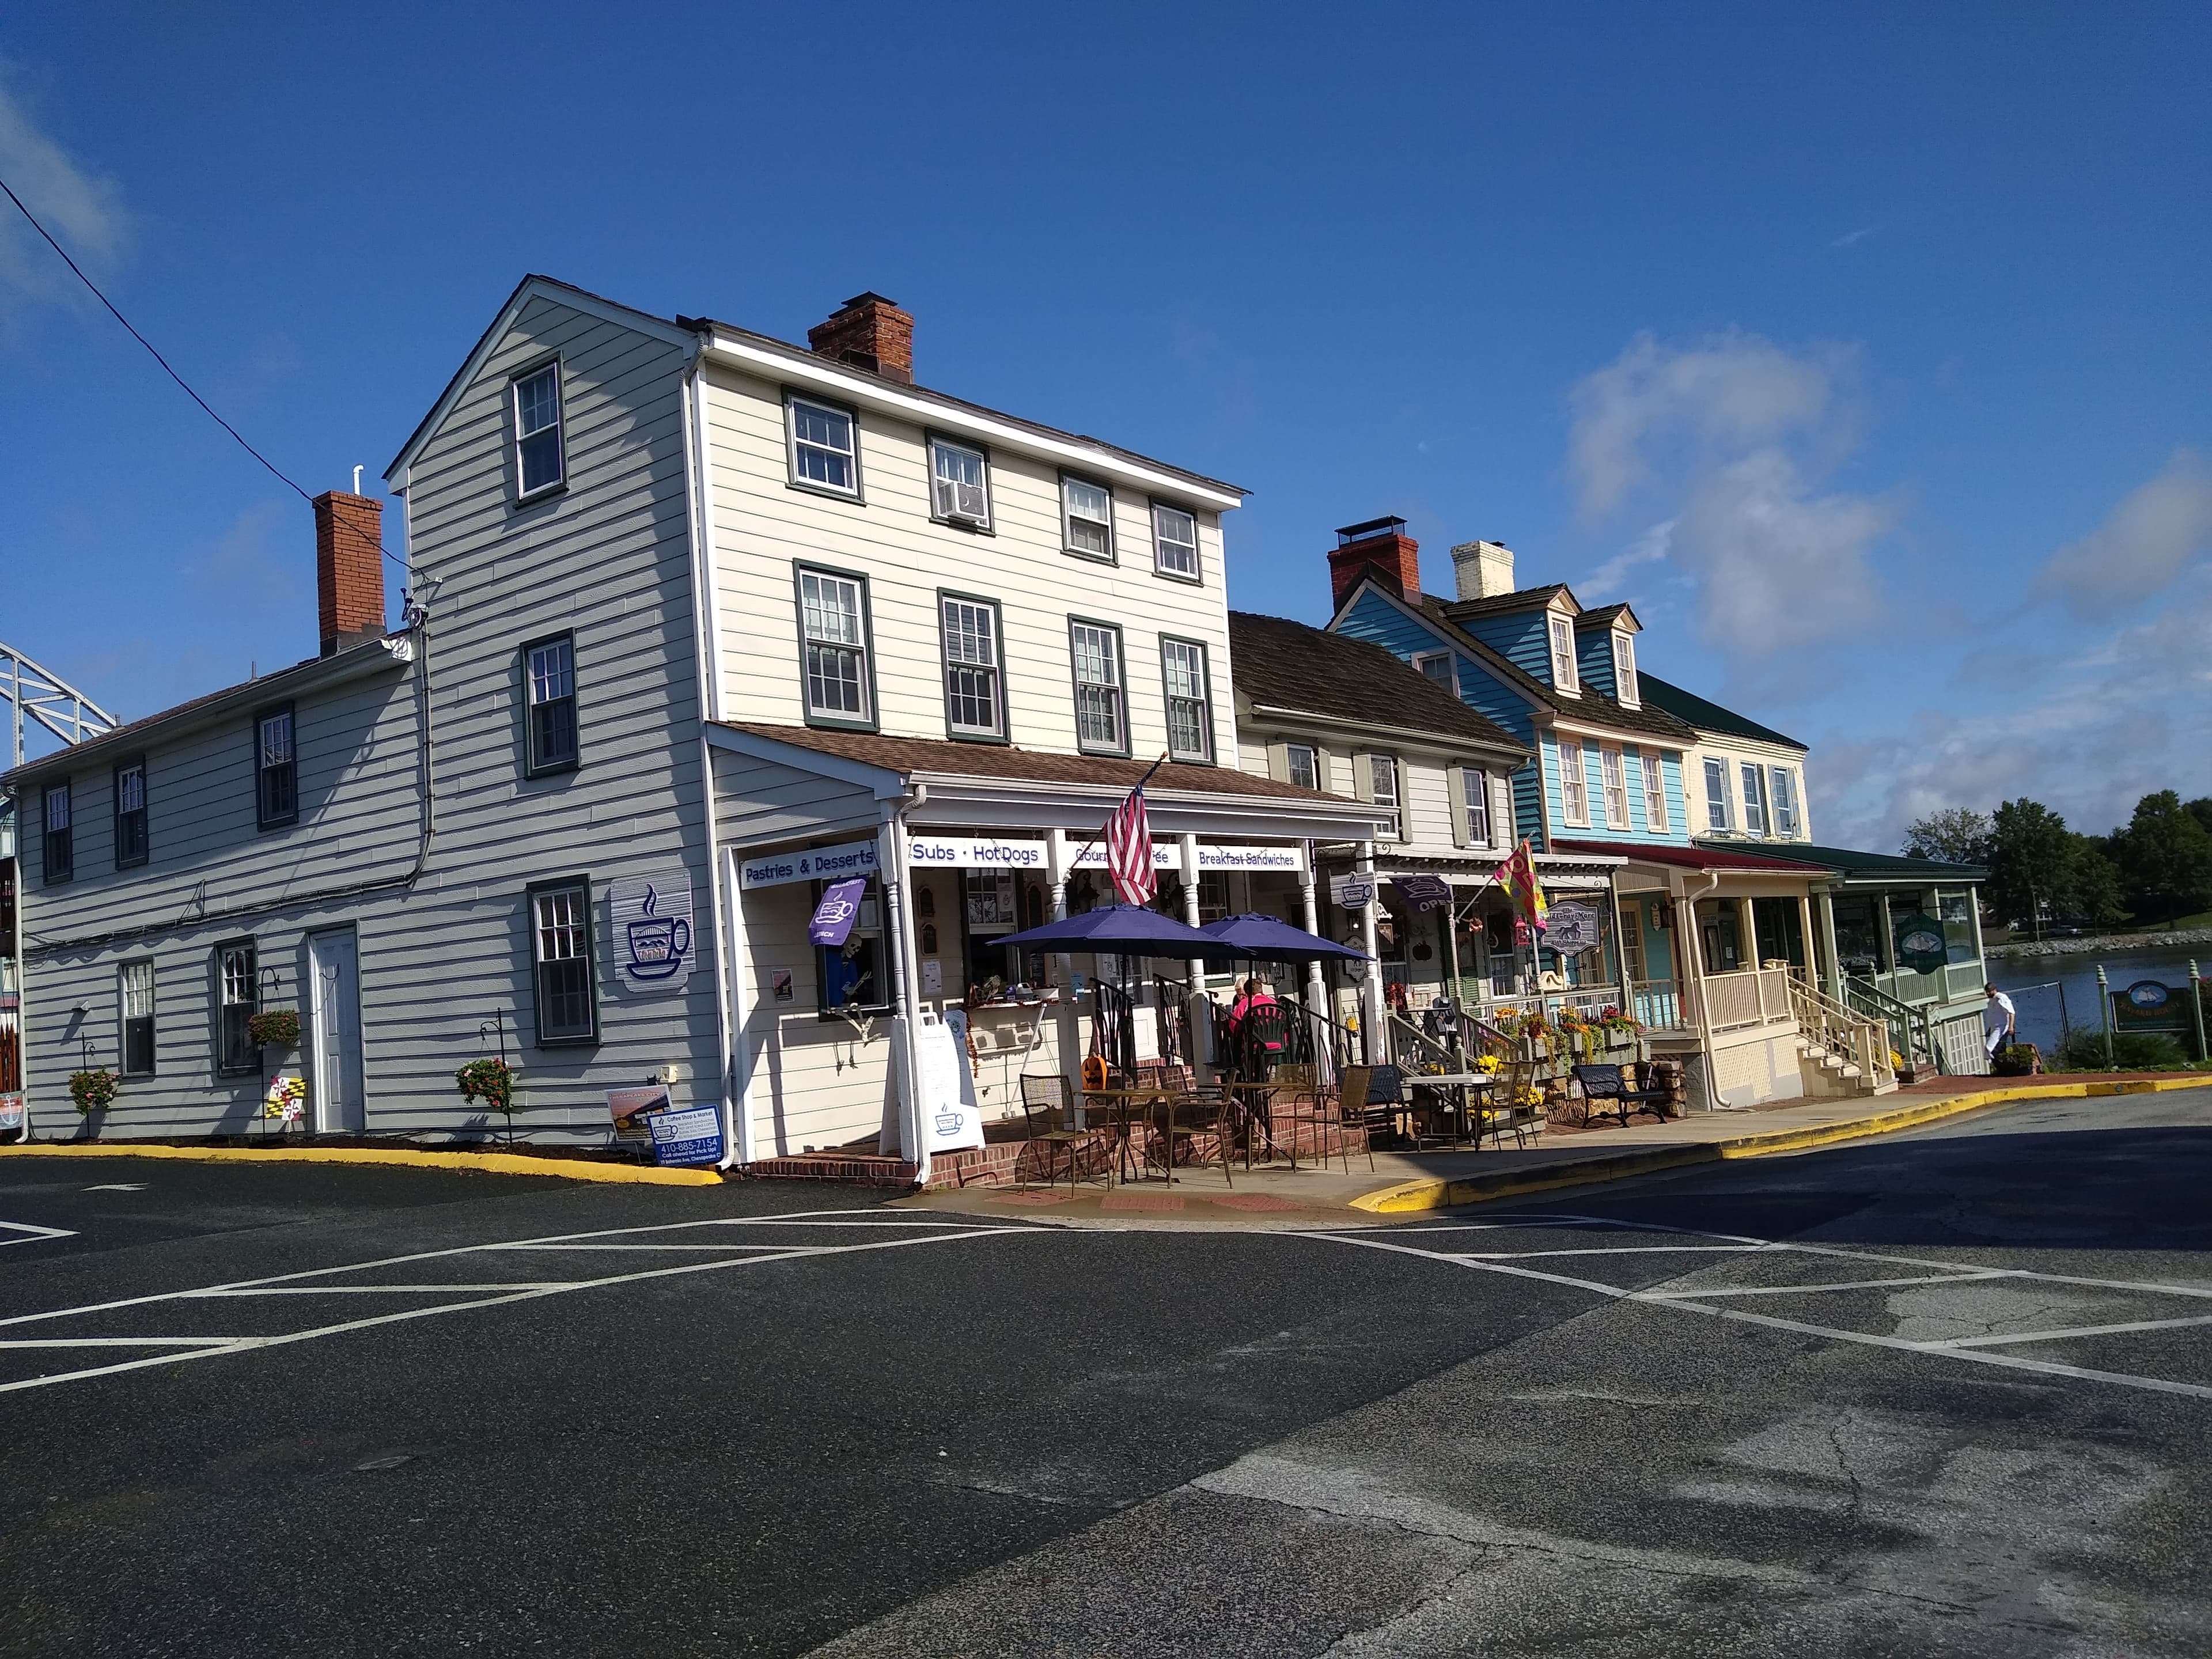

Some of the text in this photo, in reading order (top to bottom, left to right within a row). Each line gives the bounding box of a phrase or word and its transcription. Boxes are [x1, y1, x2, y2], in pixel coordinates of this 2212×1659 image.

[913, 844, 955, 861] Subs
[1199, 851, 1294, 866] Breakfast Sandwiches
[746, 849, 874, 881] Pastries & Desserts
[661, 1138, 718, 1153] 410-885-7154
